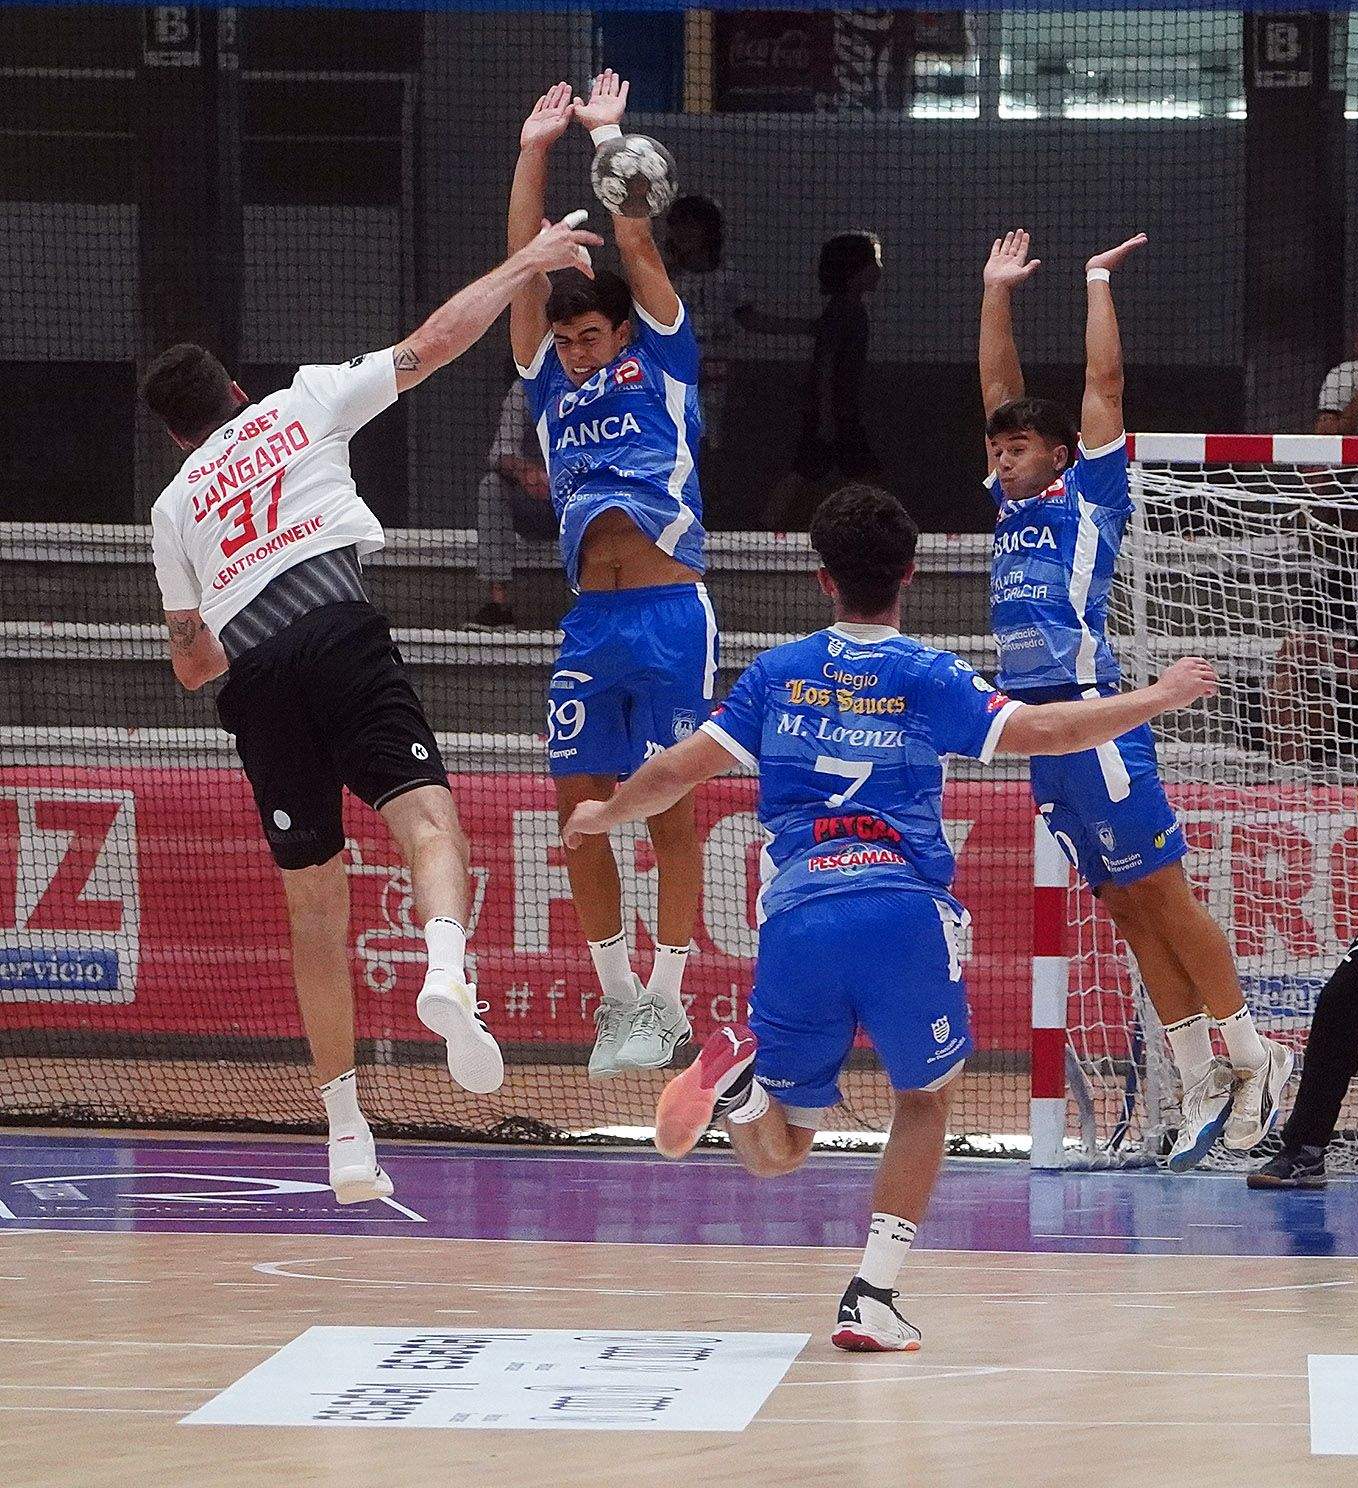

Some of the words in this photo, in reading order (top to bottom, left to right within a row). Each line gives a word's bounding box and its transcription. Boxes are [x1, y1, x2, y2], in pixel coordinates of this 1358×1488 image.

[556, 412, 642, 450] ANCA
[192, 420, 310, 524] LANGARO
[217, 466, 287, 558] 37
[212, 514, 326, 590] CENTROKINETIC
[786, 679, 832, 707] Los
[836, 687, 906, 716] Sauces
[777, 713, 807, 737] M.
[813, 755, 874, 808] 7
